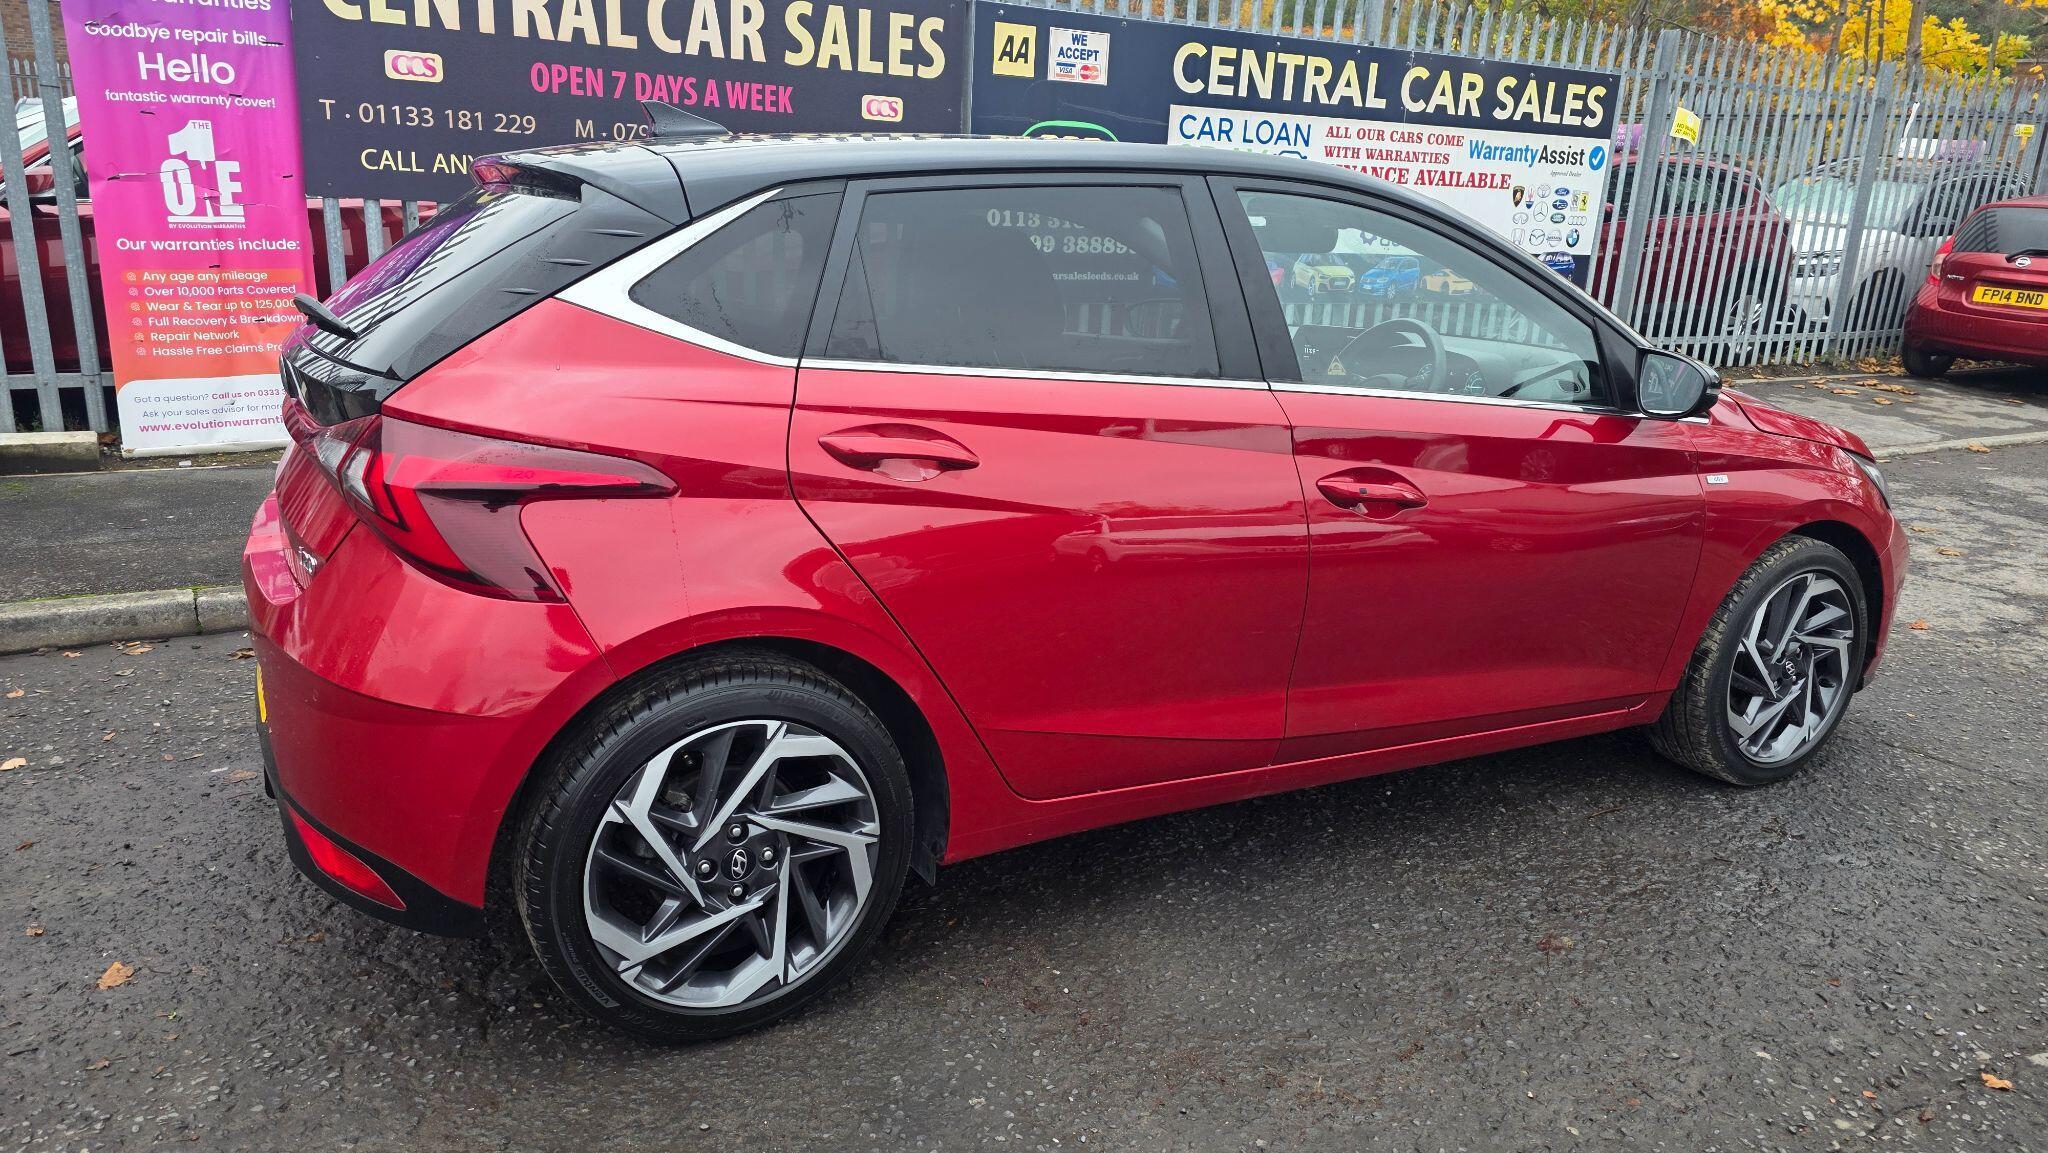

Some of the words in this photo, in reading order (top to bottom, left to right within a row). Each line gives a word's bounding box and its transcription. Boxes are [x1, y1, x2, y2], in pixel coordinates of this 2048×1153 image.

[85, 21, 170, 43] Goodbye
[174, 28, 228, 46] repair
[647, 0, 766, 62] CAR
[784, 0, 946, 79] SALES
[1071, 32, 1088, 46] WE
[997, 34, 1030, 65] AA
[1057, 46, 1100, 62] ACCEPT
[137, 51, 235, 85] Hello
[530, 62, 604, 98] OPEN
[611, 70, 627, 99] 7
[634, 71, 698, 106] DAYS
[703, 78, 721, 108] A
[724, 80, 794, 114] WEEK
[1172, 42, 1387, 110] CENTRAL
[1401, 66, 1485, 118] CAR
[1492, 75, 1607, 128] SALES
[105, 89, 167, 103] fantastic
[169, 94, 231, 109] warranty
[235, 97, 276, 108] cover!
[191, 121, 211, 130] THE
[359, 102, 434, 127] 01133
[445, 109, 483, 130] 181
[494, 113, 536, 135] 229
[1179, 114, 1234, 142] CAR
[1242, 119, 1312, 148] LOAN
[1325, 125, 1351, 139] ALL
[1356, 127, 1386, 142] OUR
[1390, 130, 1424, 145] CARS
[1427, 133, 1465, 147] COME
[360, 148, 425, 173] CALL
[1324, 145, 1361, 160] WITH
[1365, 147, 1451, 165] WARRANTIES
[1413, 169, 1512, 190] AVAILABLE
[116, 238, 146, 251] Our
[150, 238, 234, 251] warranties
[238, 238, 300, 251] include:
[143, 271, 166, 283] Any
[170, 272, 194, 283] age
[198, 272, 221, 283] any
[222, 270, 268, 282] mileage
[144, 286, 175, 297] Over
[177, 286, 215, 298] 10,000
[218, 285, 244, 295] Parts
[246, 284, 297, 295] Covered
[1982, 288, 2011, 303] FP14
[2015, 291, 2044, 306] BND
[146, 301, 180, 312] Wear
[183, 301, 193, 311] &
[195, 300, 222, 311] Tear
[224, 300, 237, 312] up
[240, 300, 253, 310] to
[148, 316, 169, 327] Full
[172, 315, 227, 328] Recovery
[229, 315, 237, 325] &
[239, 313, 304, 325] Breakdown
[151, 331, 190, 344] Repair
[193, 329, 240, 341] Network
[152, 345, 193, 356] Hassle
[196, 344, 222, 355] Free
[224, 343, 264, 354] Claims
[134, 395, 151, 404] Got
[163, 393, 209, 404] question?
[211, 391, 229, 400] Call
[231, 391, 242, 399] us
[244, 390, 256, 398] on
[258, 388, 280, 397] 0333
[142, 409, 159, 418] Ask
[162, 409, 182, 420] your
[185, 406, 210, 417] sales
[211, 404, 244, 415] advisor
[246, 403, 259, 412] for
